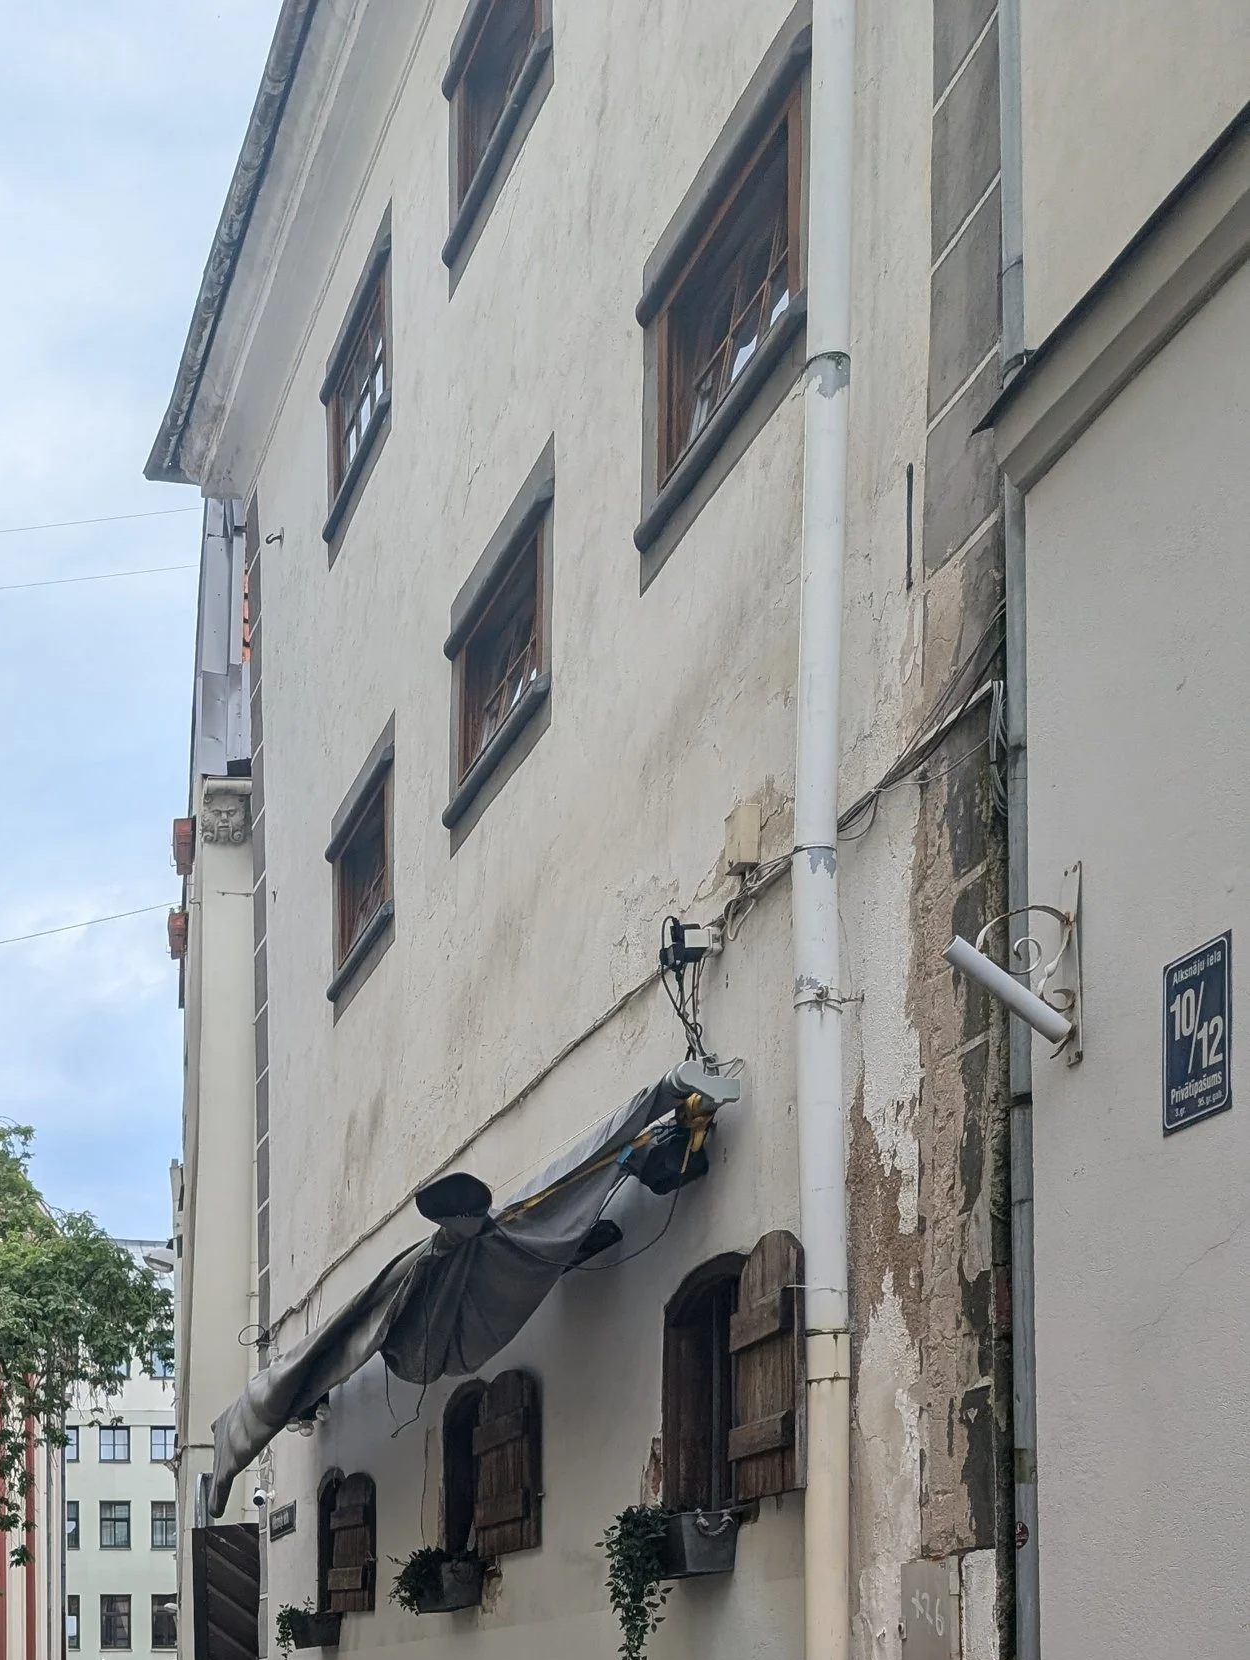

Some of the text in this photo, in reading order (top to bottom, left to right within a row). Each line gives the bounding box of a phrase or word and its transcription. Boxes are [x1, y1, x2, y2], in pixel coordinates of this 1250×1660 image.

[1172, 950, 1222, 987] Alksnāju iela
[1170, 1071, 1223, 1105] Privātīpašums
